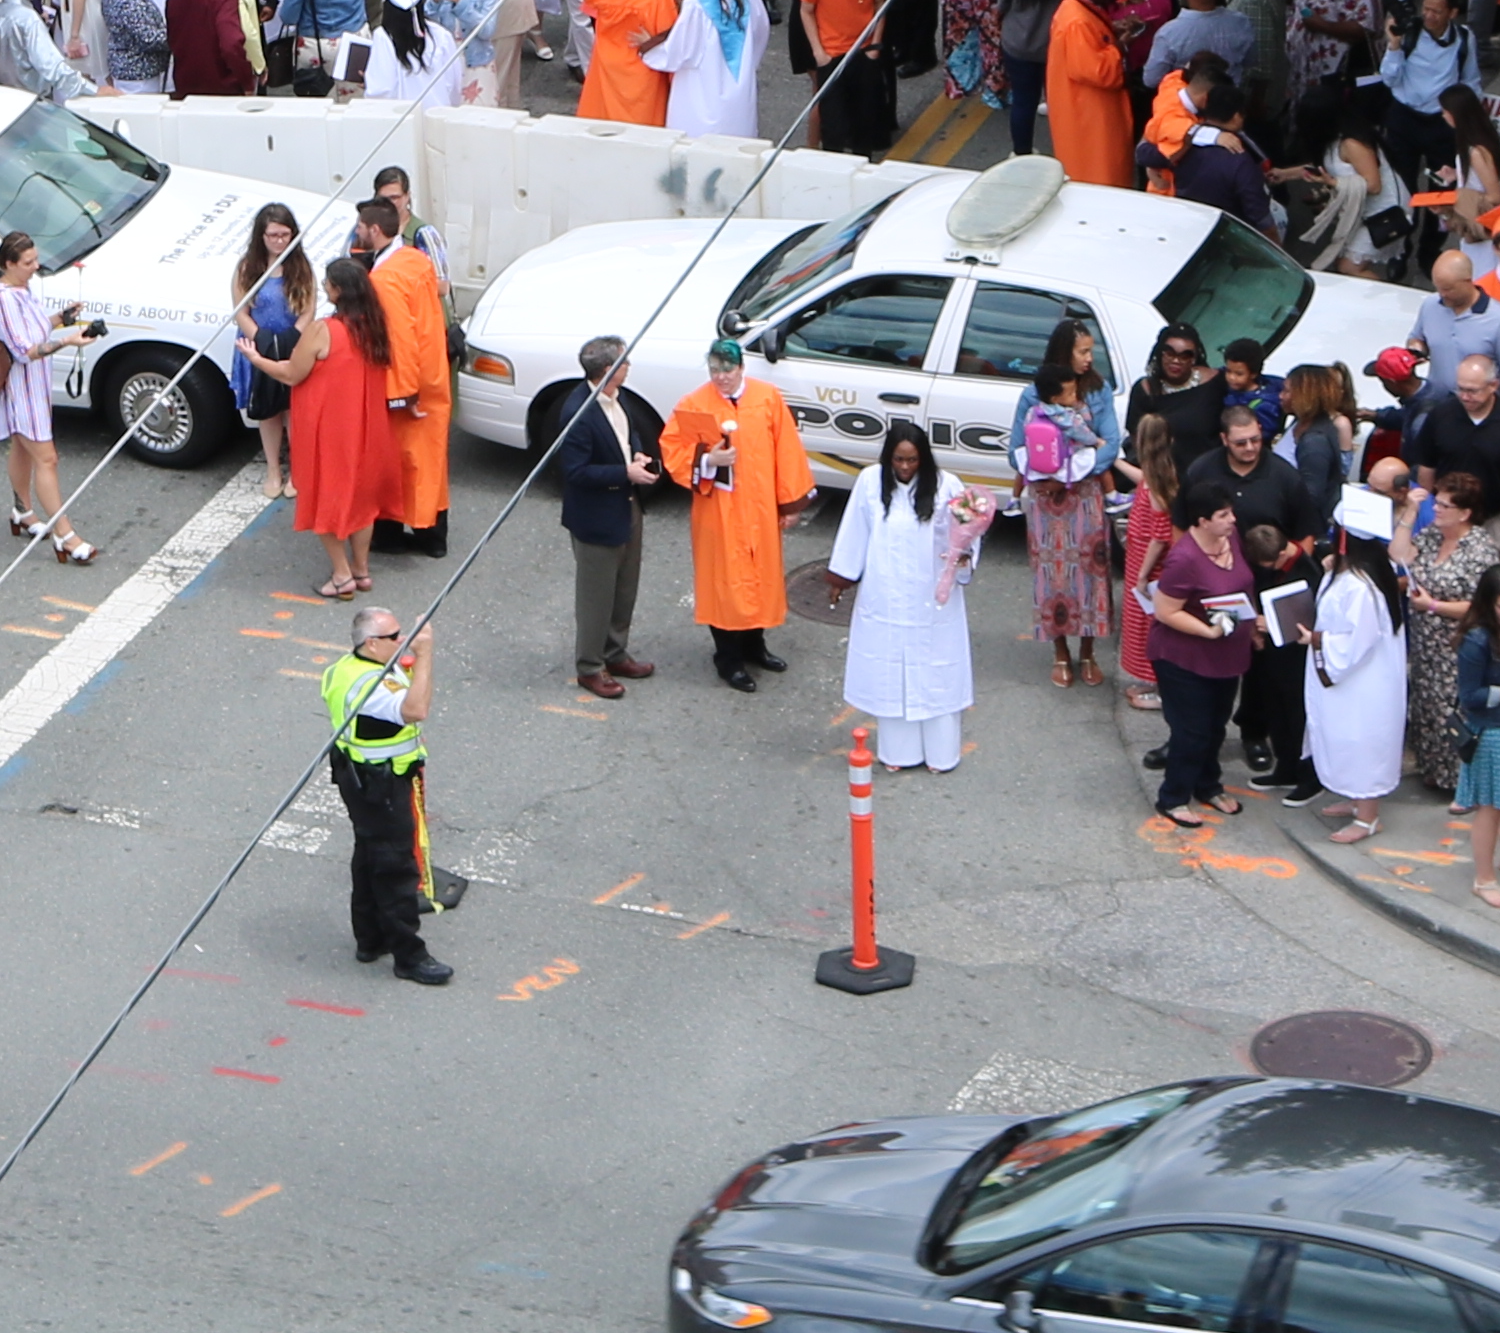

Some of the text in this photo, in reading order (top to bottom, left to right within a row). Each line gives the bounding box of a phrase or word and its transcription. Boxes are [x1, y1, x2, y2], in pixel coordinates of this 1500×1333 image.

[158, 247, 186, 265] The
[176, 225, 208, 246] Price
[215, 194, 241, 208] DUI
[81, 300, 113, 316] RIDE
[118, 304, 132, 318] IS
[138, 306, 187, 323] ABOUT
[815, 386, 858, 406] VCU
